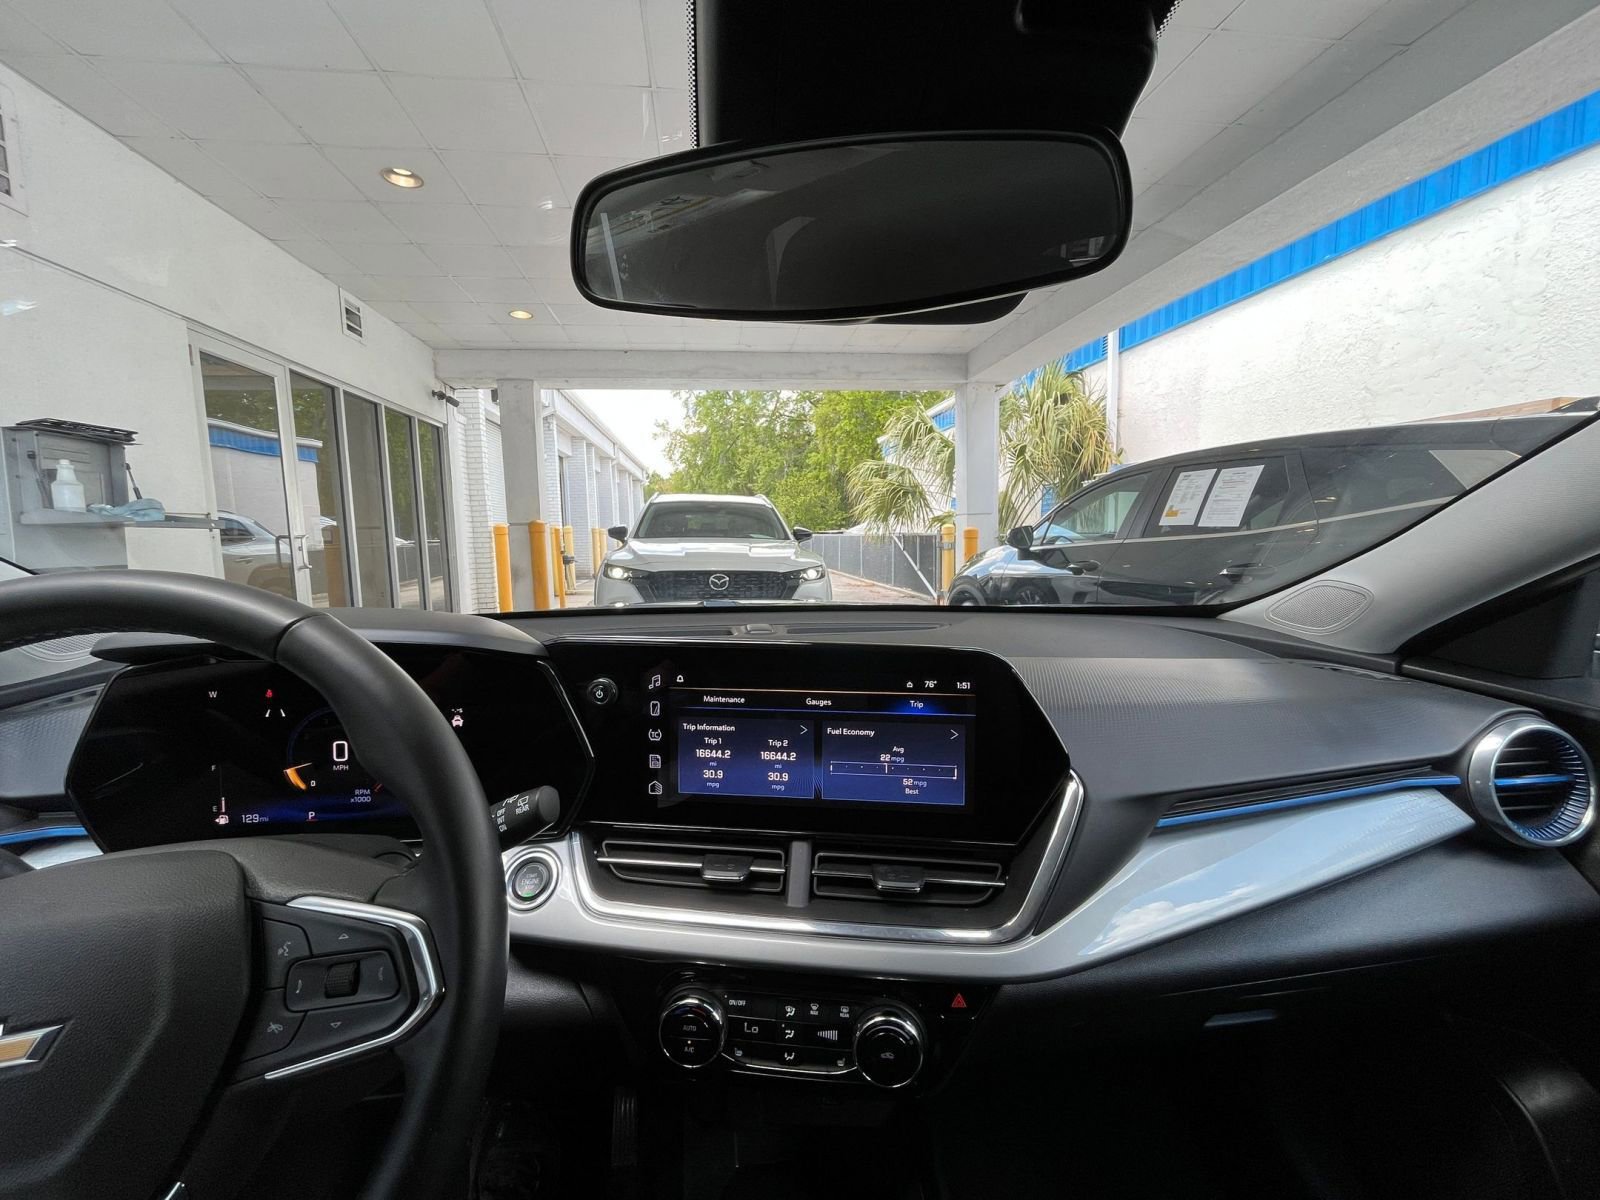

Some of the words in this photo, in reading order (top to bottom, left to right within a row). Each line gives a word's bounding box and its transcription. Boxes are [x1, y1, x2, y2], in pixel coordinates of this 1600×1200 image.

[956, 682, 971, 690] 1:51
[703, 695, 746, 704] Maintenance
[805, 697, 832, 707] Gauges
[909, 700, 924, 710] Trip
[682, 722, 697, 731] Trip
[697, 723, 736, 732] Information
[827, 727, 842, 735] Fuel
[843, 728, 875, 737] Economy
[704, 737, 718, 745] Trip
[768, 739, 782, 747] Trip
[782, 739, 789, 747] 2
[332, 740, 349, 762] 0
[695, 749, 731, 759] 16644.2
[892, 746, 905, 754] Avg
[760, 751, 797, 761] 16644.2
[703, 770, 724, 779] 30.9
[767, 772, 789, 781] 30.9
[706, 781, 720, 789] mpg
[354, 788, 371, 796] RPM
[515, 804, 530, 815] REAR
[308, 811, 316, 820] P
[682, 1024, 697, 1032] AUTO
